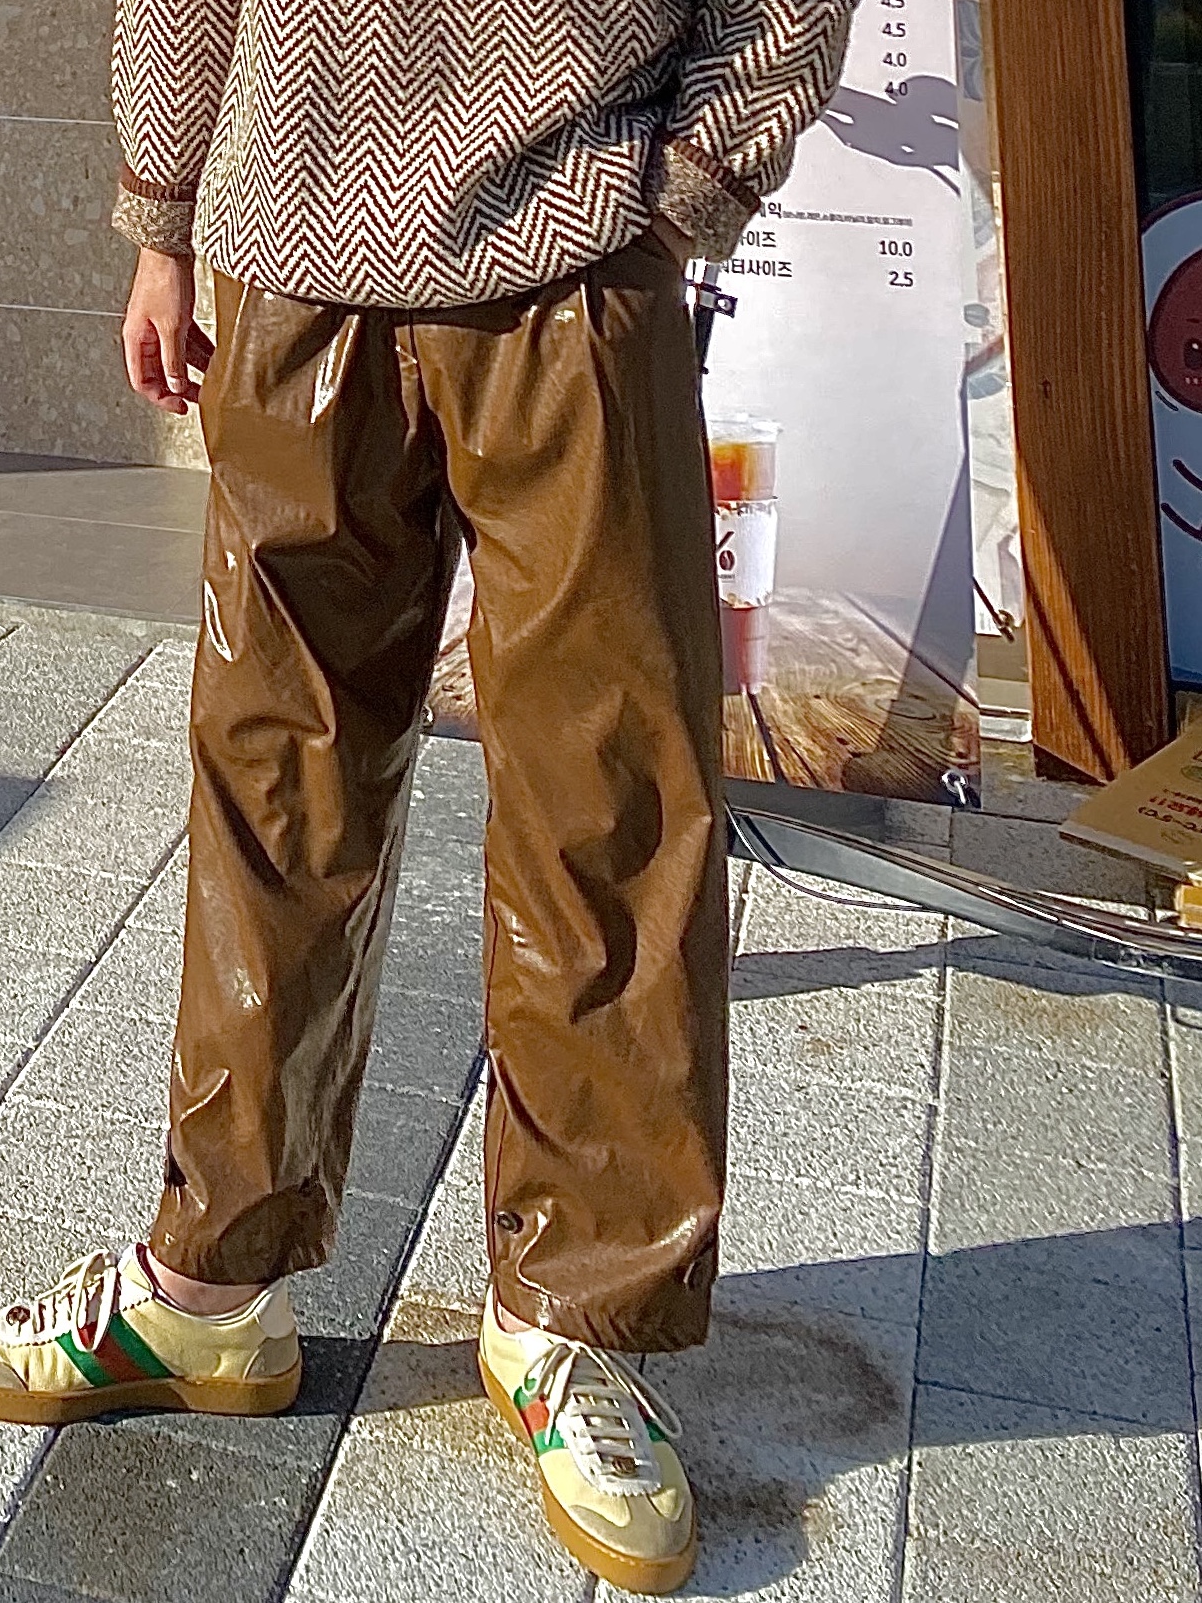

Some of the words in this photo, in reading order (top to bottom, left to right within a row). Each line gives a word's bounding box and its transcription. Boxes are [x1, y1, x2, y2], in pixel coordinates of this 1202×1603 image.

[882, 22, 907, 38] 4.5
[882, 52, 908, 67] 4.0
[884, 81, 909, 97] 4.0
[878, 240, 914, 256] 10.0
[888, 271, 914, 288] 2.5
